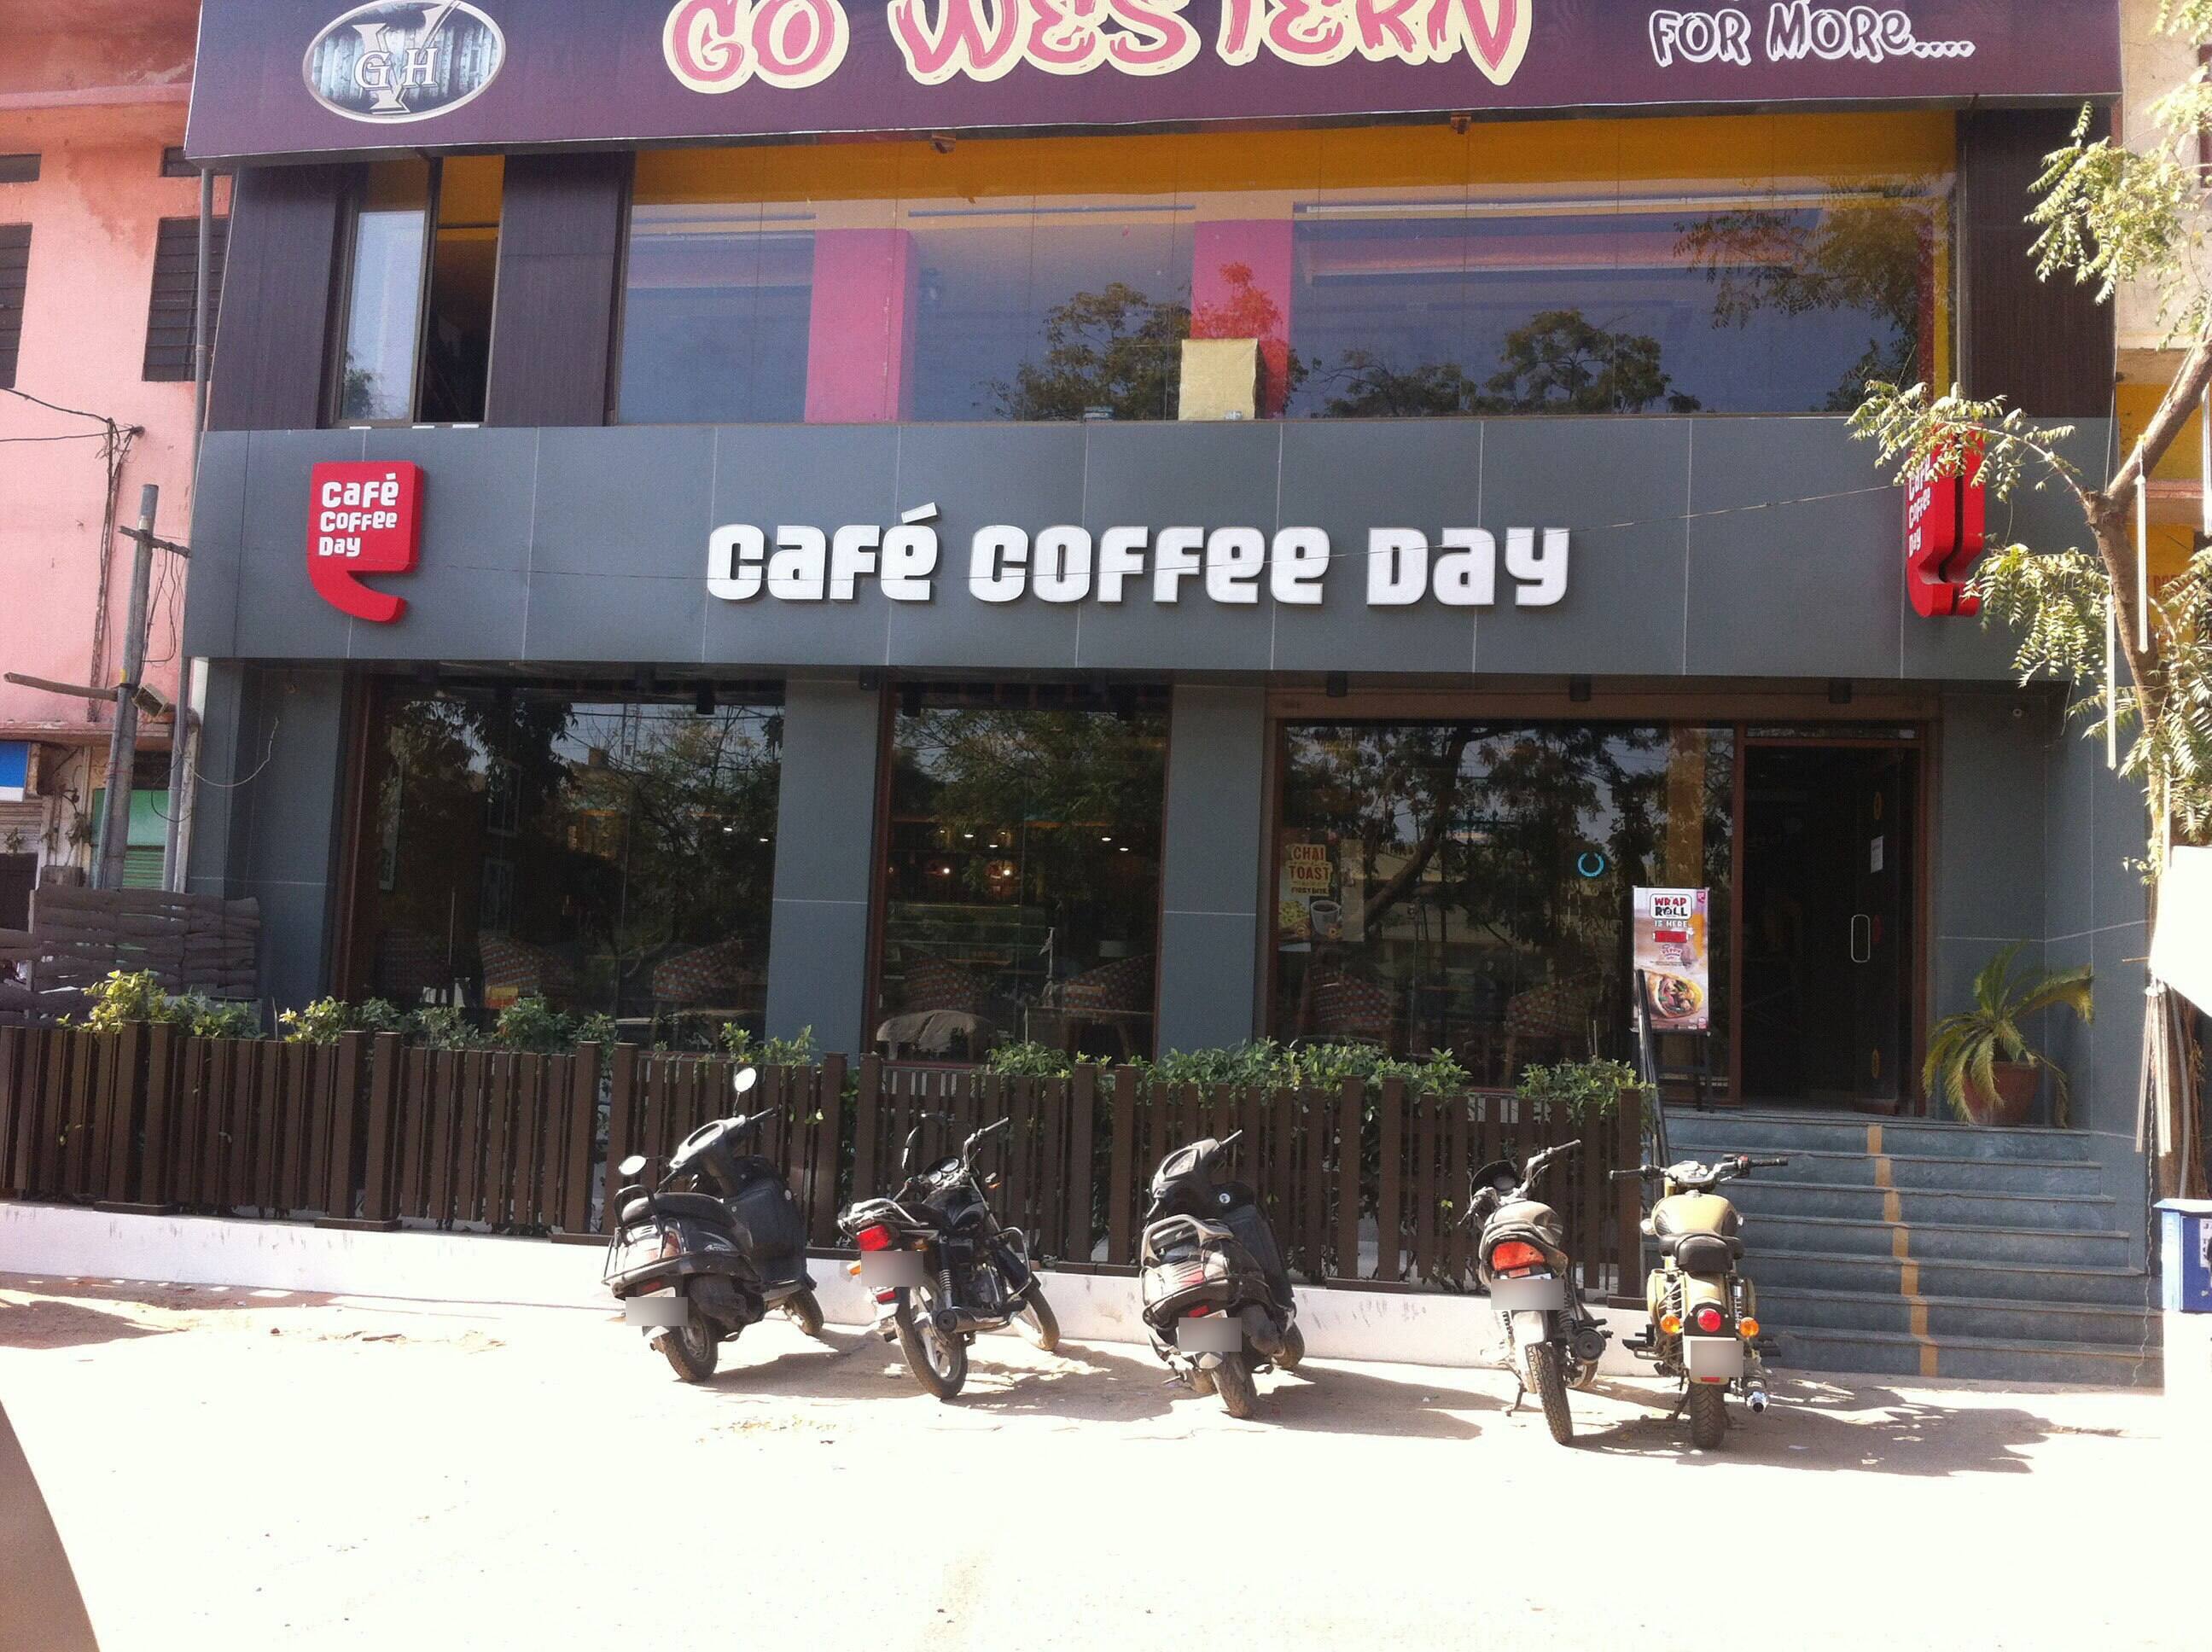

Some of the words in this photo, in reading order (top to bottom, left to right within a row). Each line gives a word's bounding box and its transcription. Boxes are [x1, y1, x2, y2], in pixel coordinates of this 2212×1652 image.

[663, 0, 850, 94] GO
[1649, 8, 1751, 67] FOR
[322, 473, 399, 509] Café
[320, 510, 398, 533] Coffee
[318, 536, 361, 557] Day
[707, 502, 938, 601] Café
[969, 524, 1330, 604] Coffee
[1366, 526, 1571, 606] Day
[1293, 846, 1324, 861] CHAI
[1289, 864, 1330, 881] TOAST
[1655, 897, 1687, 906] WRAP
[1655, 906, 1688, 916] ROLL
